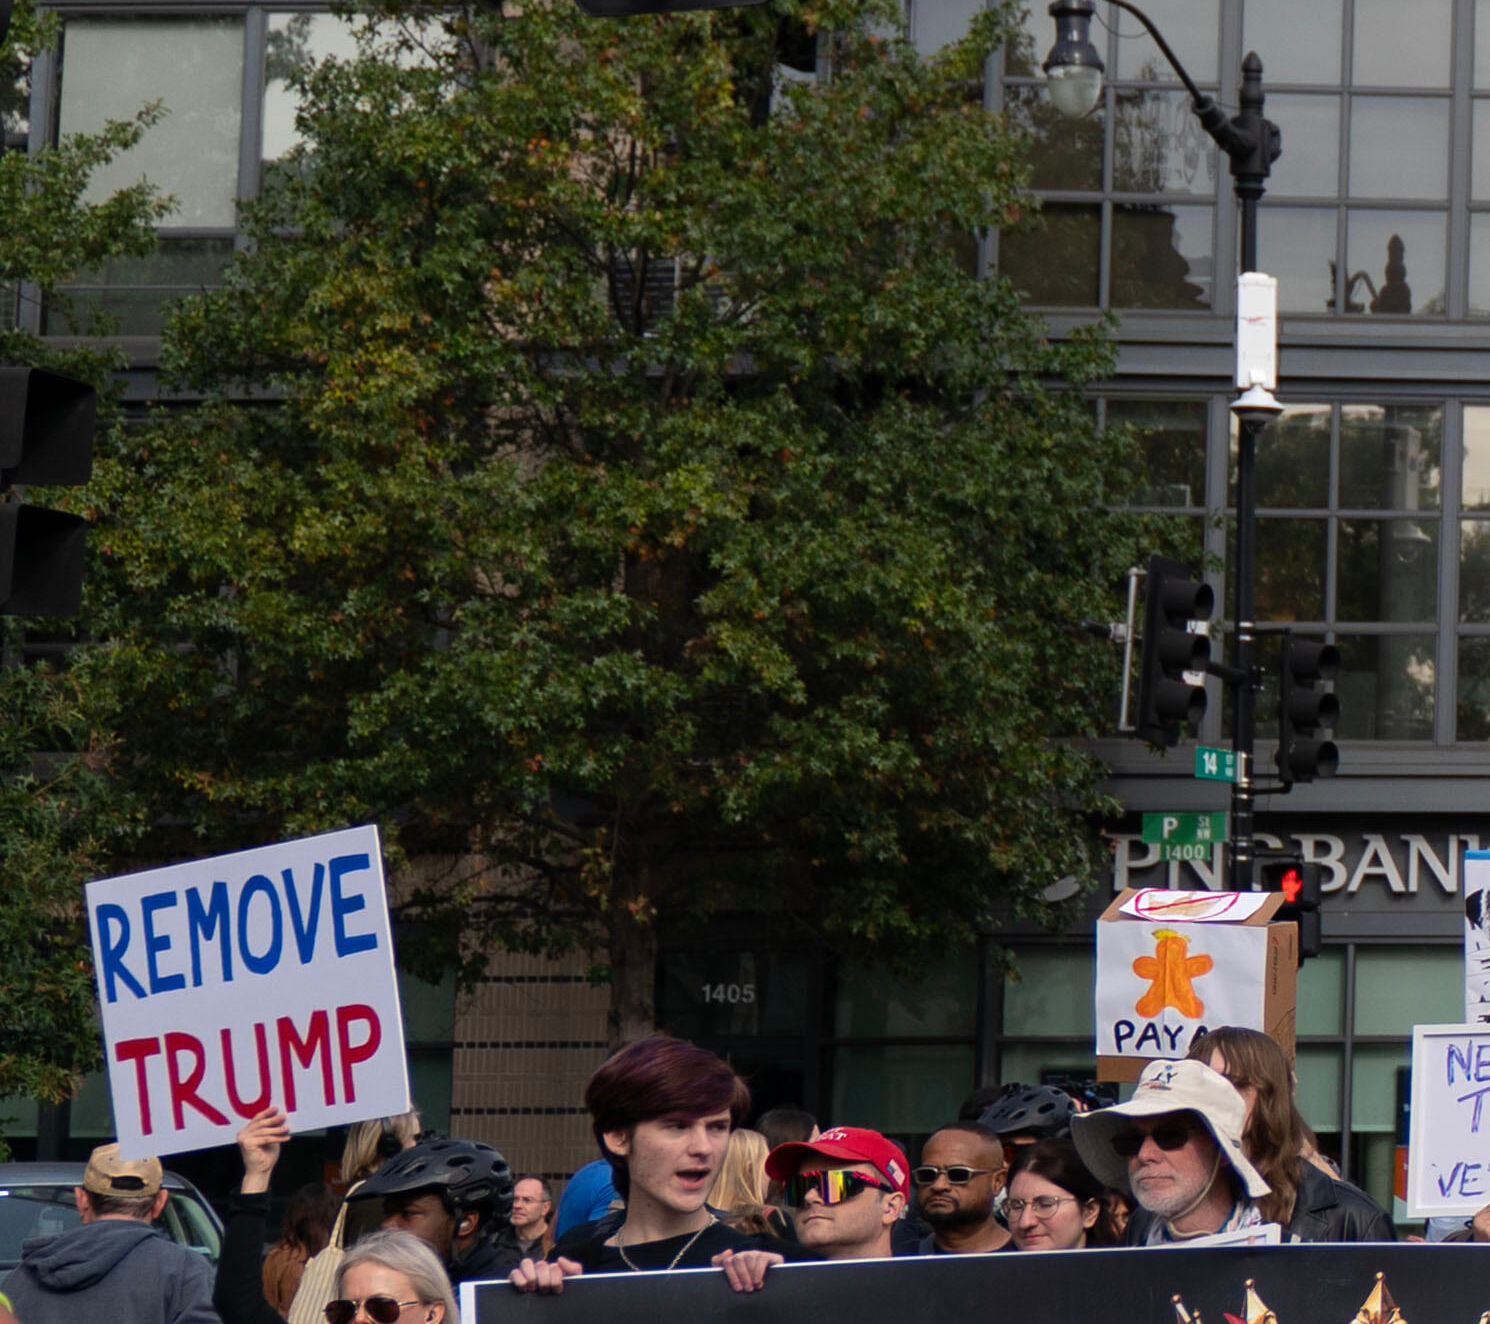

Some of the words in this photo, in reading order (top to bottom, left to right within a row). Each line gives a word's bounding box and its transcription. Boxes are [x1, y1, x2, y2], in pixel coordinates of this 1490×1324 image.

[1202, 751, 1218, 775] 14
[1162, 816, 1179, 839] P
[1164, 845, 1205, 861] 1400
[96, 853, 379, 1004] REMOVE
[701, 983, 757, 1006] 1405
[114, 1003, 383, 1136] TRUMP
